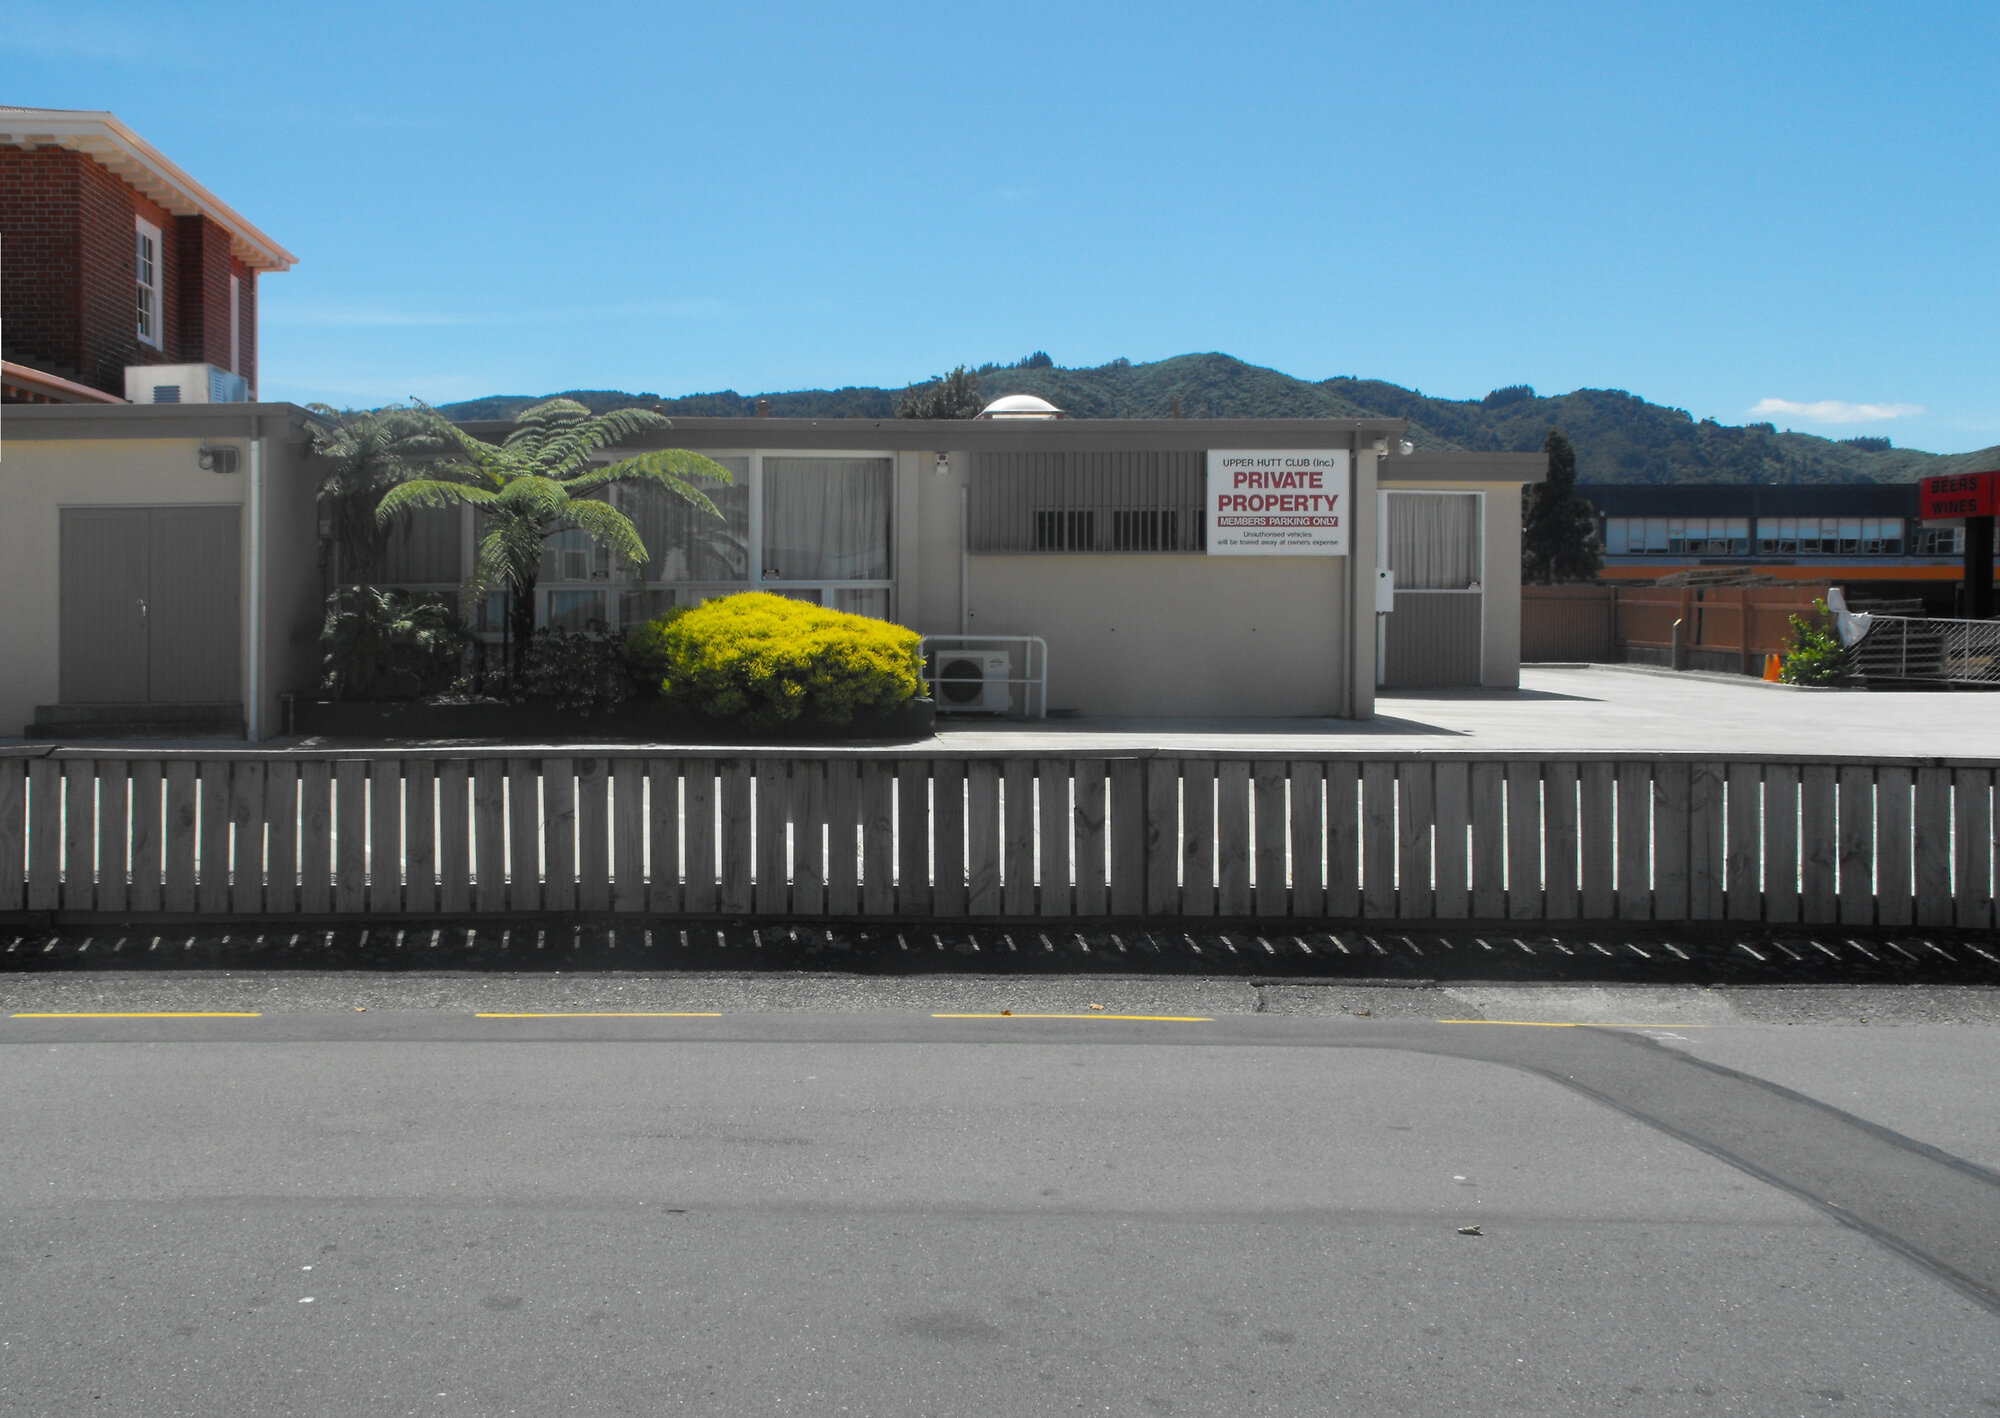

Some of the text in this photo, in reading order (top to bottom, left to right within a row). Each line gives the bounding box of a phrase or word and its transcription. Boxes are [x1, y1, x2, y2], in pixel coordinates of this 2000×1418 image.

[1223, 459, 1254, 467] UPPER
[1257, 459, 1281, 467] HUTT
[1285, 459, 1309, 467] CLUB
[1234, 472, 1323, 488] PRIVATE
[1932, 478, 1977, 493] BEERS
[1218, 495, 1338, 511] PROPERTY
[1932, 499, 1978, 514] WINES
[1269, 518, 1309, 526] PARKING
